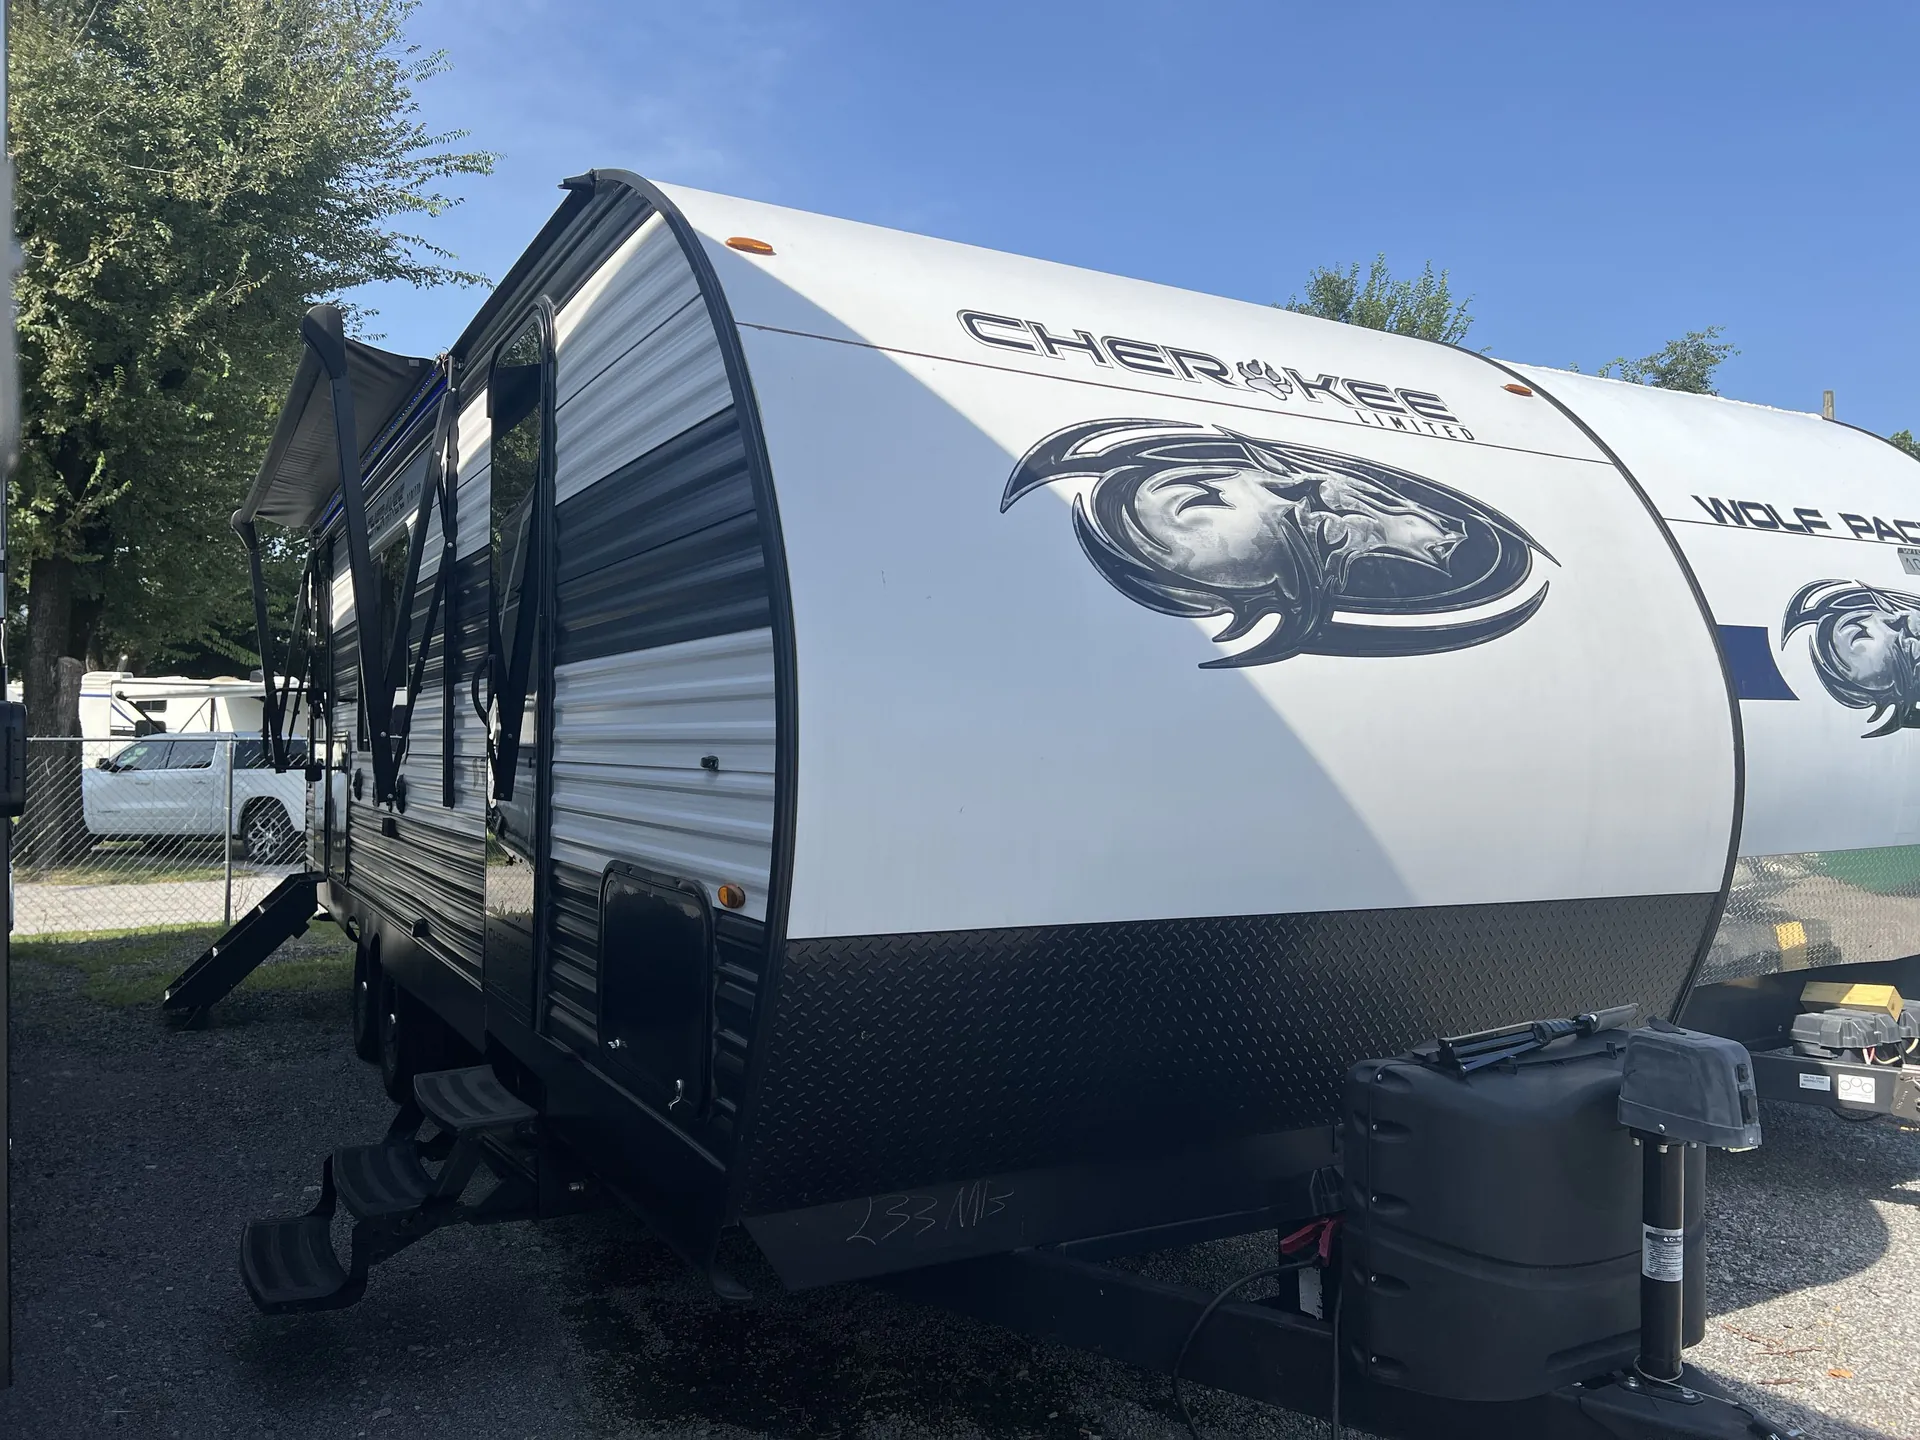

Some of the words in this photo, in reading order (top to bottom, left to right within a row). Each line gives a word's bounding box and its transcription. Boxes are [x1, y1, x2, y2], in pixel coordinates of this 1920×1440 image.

[1355, 410, 1475, 441] LIMITED
[1690, 494, 1832, 533] WOLF
[1838, 512, 1920, 545] PAC
